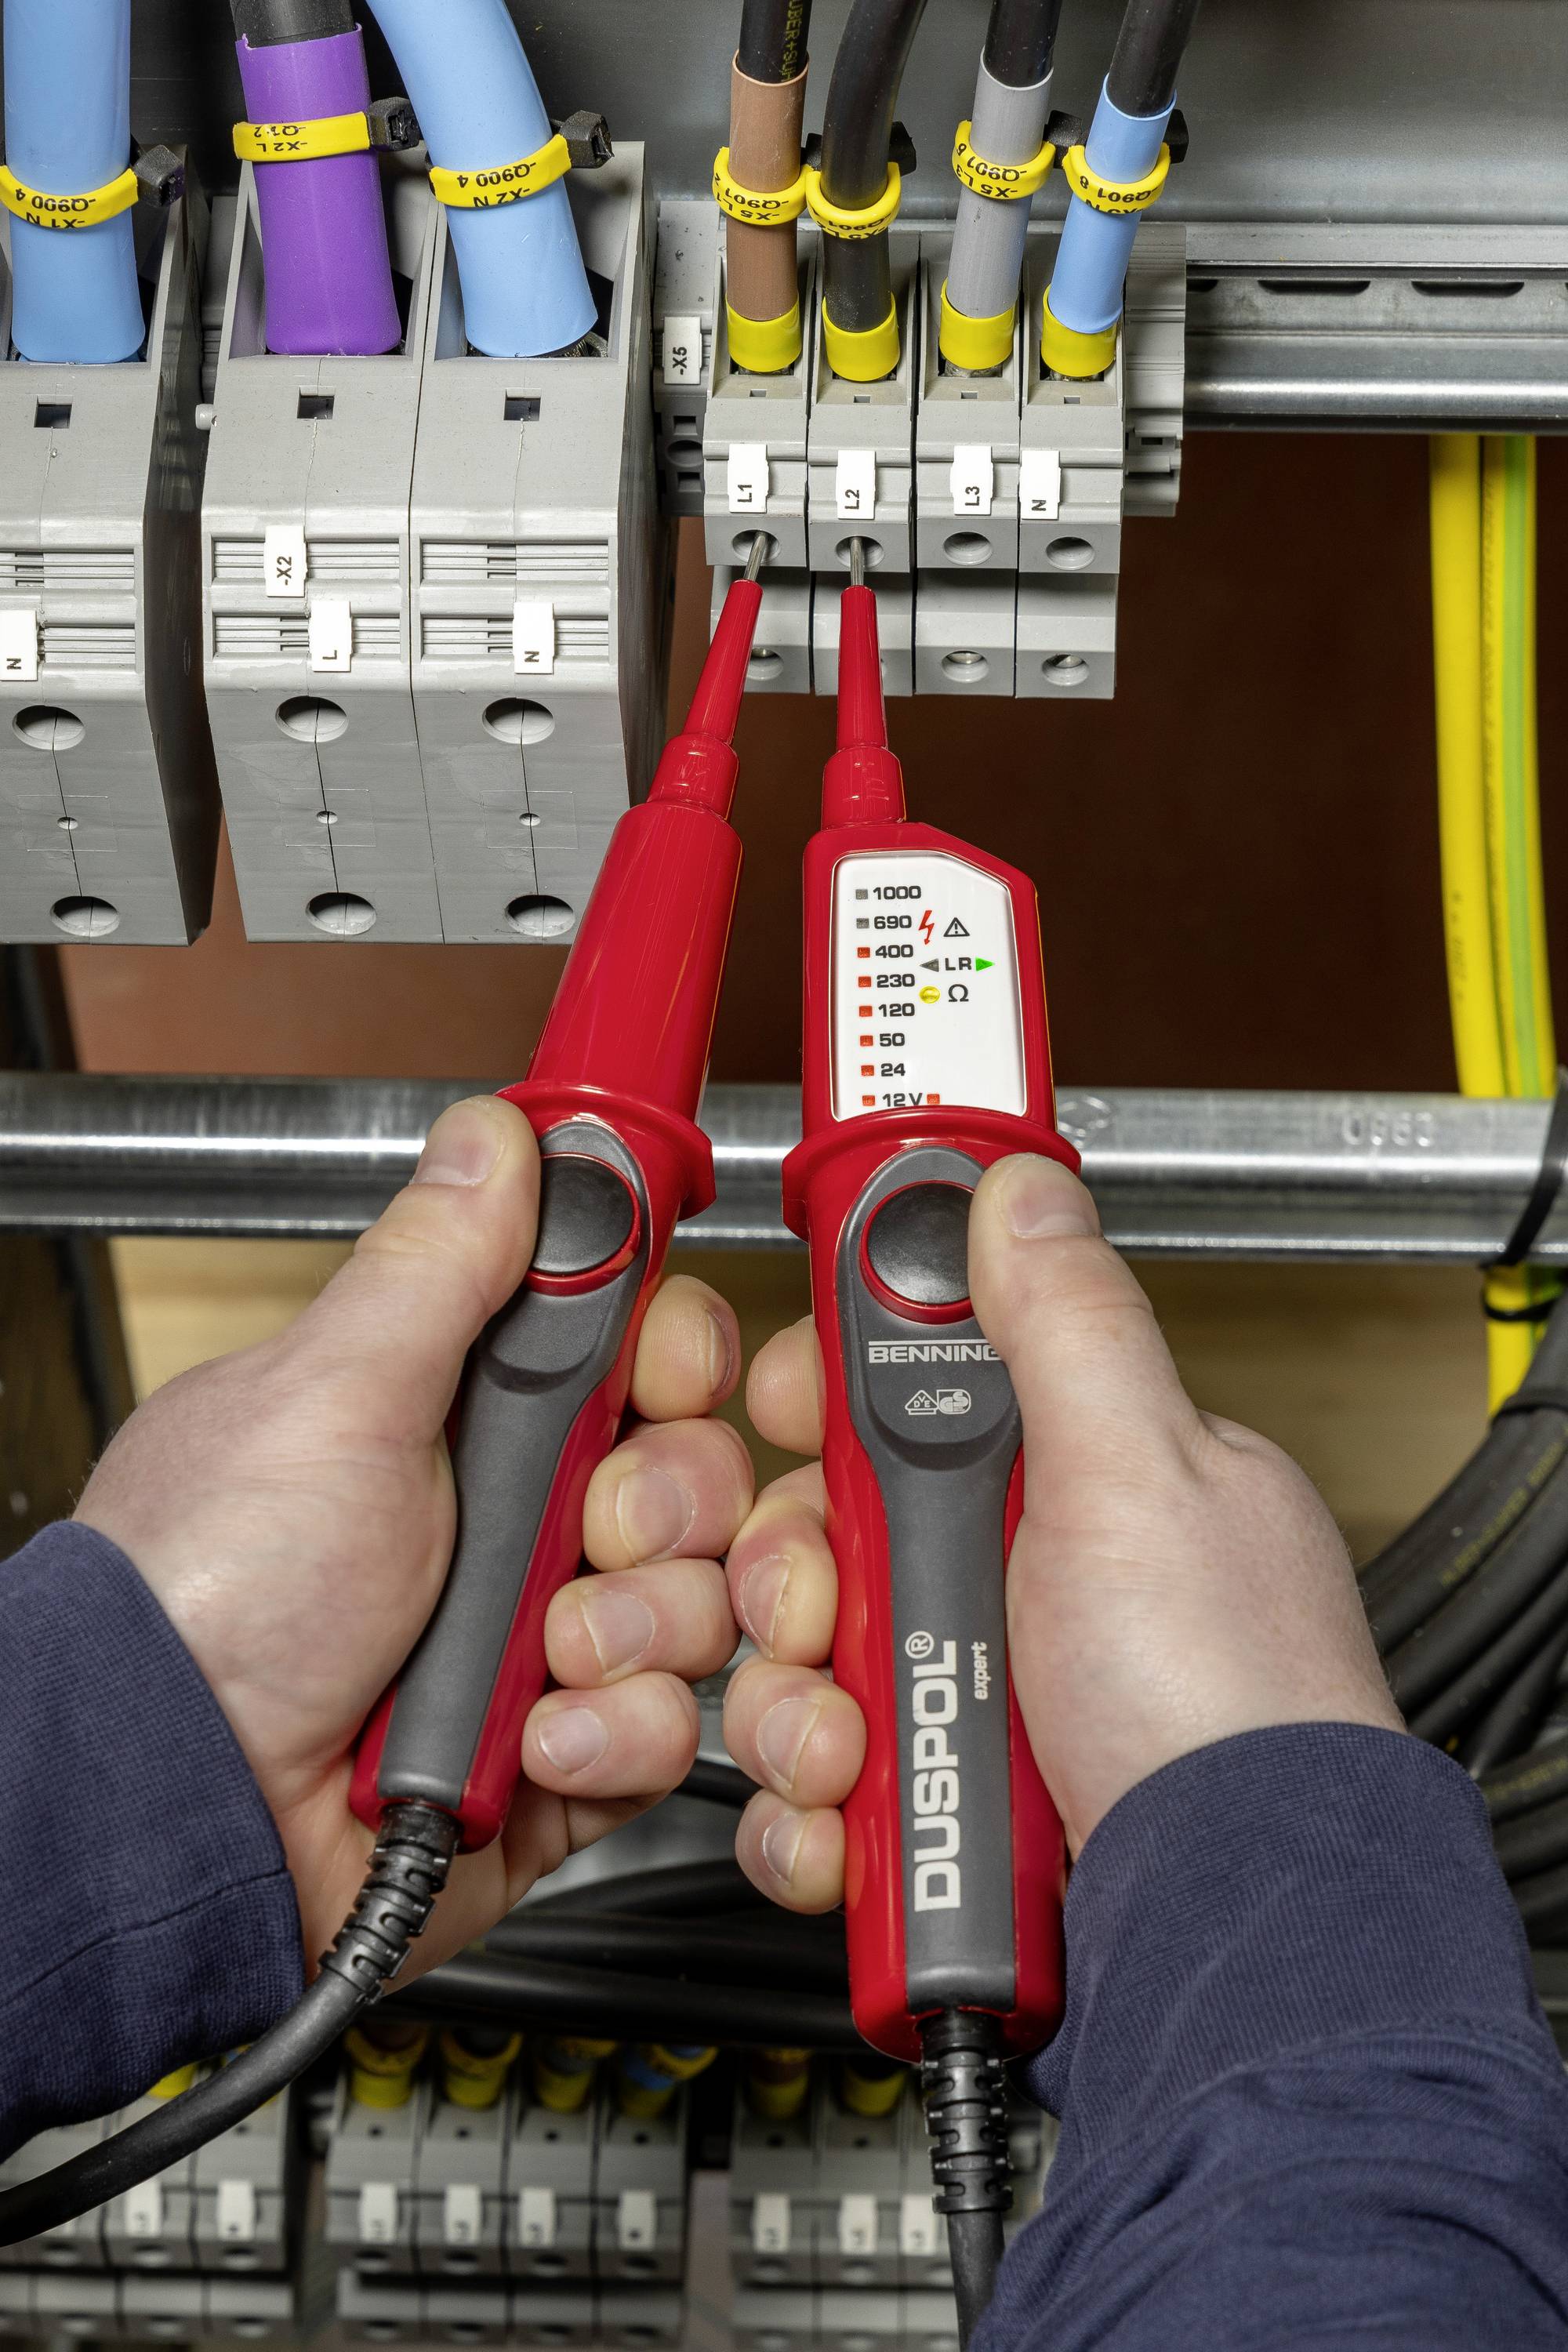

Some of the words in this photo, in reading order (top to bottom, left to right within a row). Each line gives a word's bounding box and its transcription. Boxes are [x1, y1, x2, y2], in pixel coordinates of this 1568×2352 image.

[253, 126, 263, 139] 2
[256, 143, 267, 153] L
[273, 140, 308, 152] -X2
[956, 143, 967, 157] 6
[475, 162, 537, 187] -Q900
[956, 164, 974, 187] L3
[967, 155, 1028, 182] -Q901
[456, 174, 470, 189] 4
[1080, 175, 1089, 190] 8
[15, 187, 26, 201] 4
[724, 187, 789, 209] -Q901
[980, 183, 1018, 198] -X5
[1097, 186, 1158, 203] -Q901
[31, 194, 96, 212] -Q900
[473, 195, 491, 208] N
[26, 212, 40, 226] N
[740, 209, 780, 221] -X5
[672, 346, 688, 376] -X5
[736, 483, 753, 503] L1
[844, 488, 861, 510] L2
[964, 485, 981, 506] L3
[1030, 499, 1047, 511] N
[276, 555, 292, 586] -X2
[321, 648, 338, 661] L
[523, 650, 540, 663] N
[5, 657, 23, 670] N
[872, 884, 922, 901] 1000
[873, 914, 913, 930] 690
[874, 944, 914, 959] 400
[876, 973, 916, 989] 230
[877, 1002, 916, 1018] 120
[878, 1032, 906, 1047] 50
[880, 1062, 906, 1078] 24
[868, 1344, 1004, 1364] BENNING
[970, 1641, 992, 1700] expert
